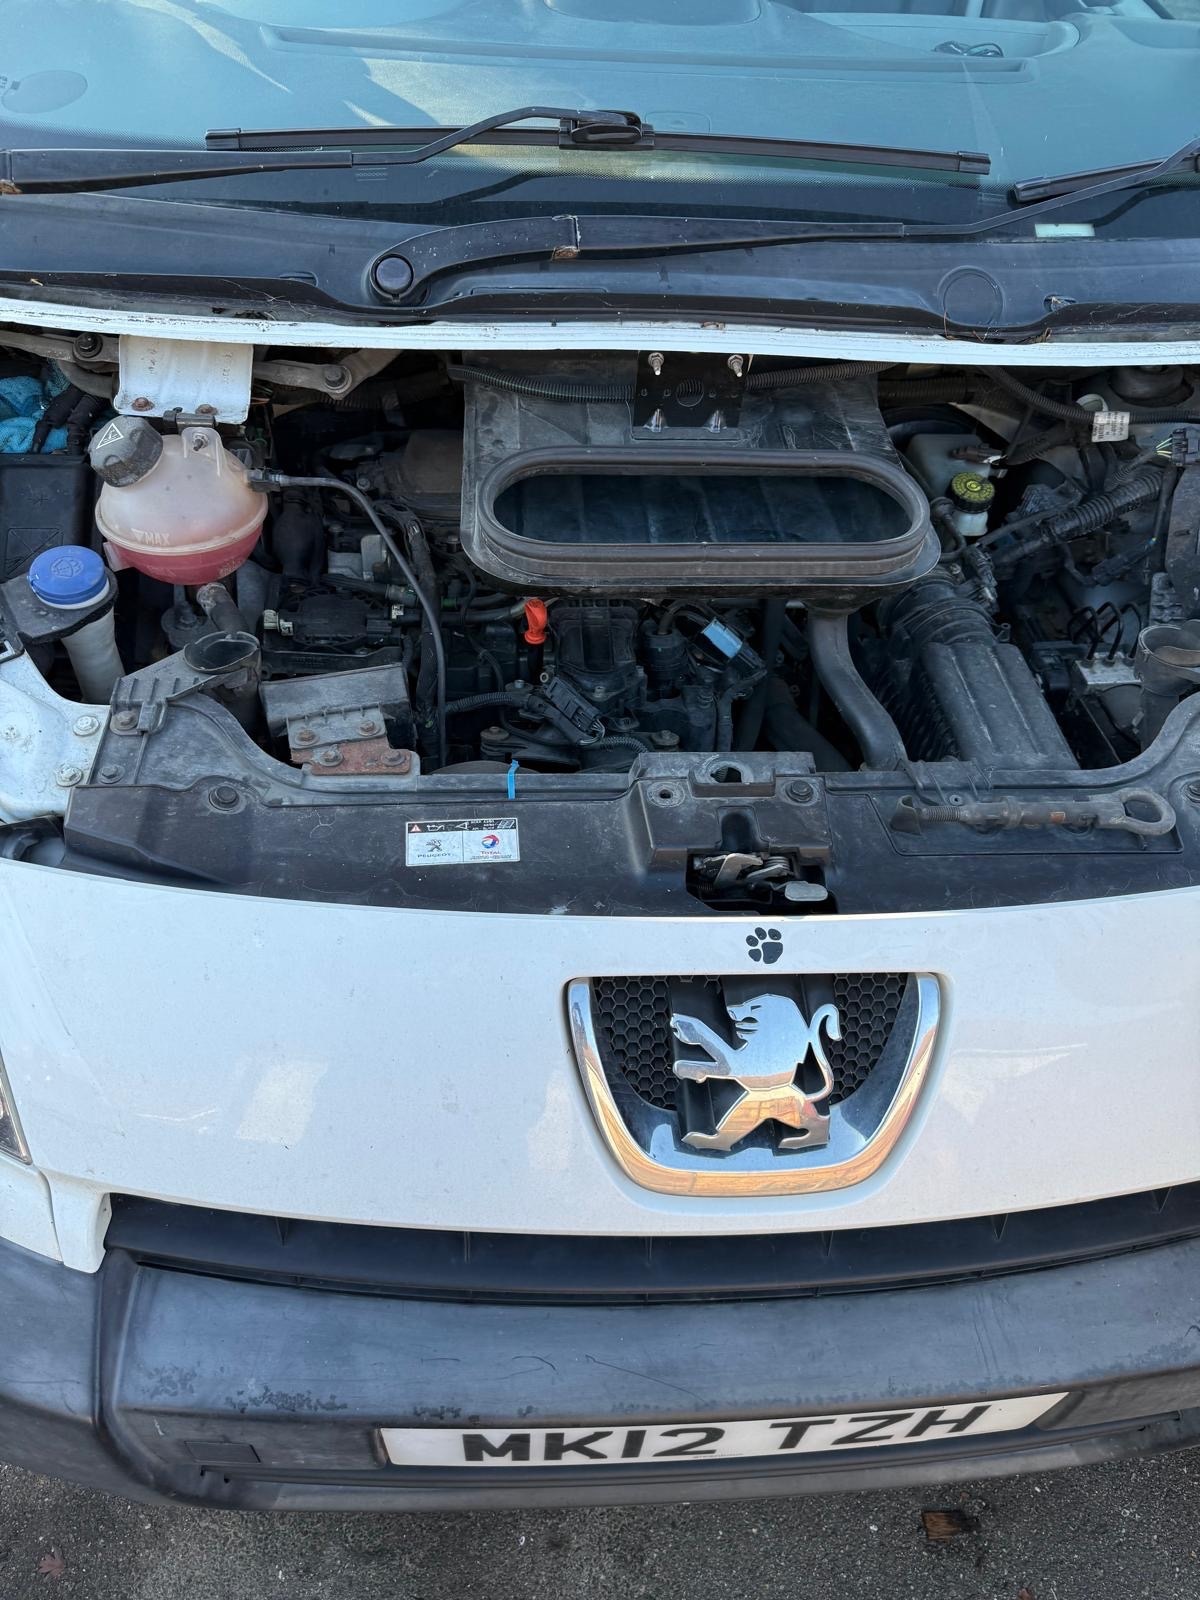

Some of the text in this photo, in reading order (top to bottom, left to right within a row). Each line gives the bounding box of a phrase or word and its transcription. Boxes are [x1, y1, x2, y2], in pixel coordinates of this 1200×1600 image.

[144, 531, 171, 547] MAX
[462, 1405, 992, 1461] MK12 TZH
